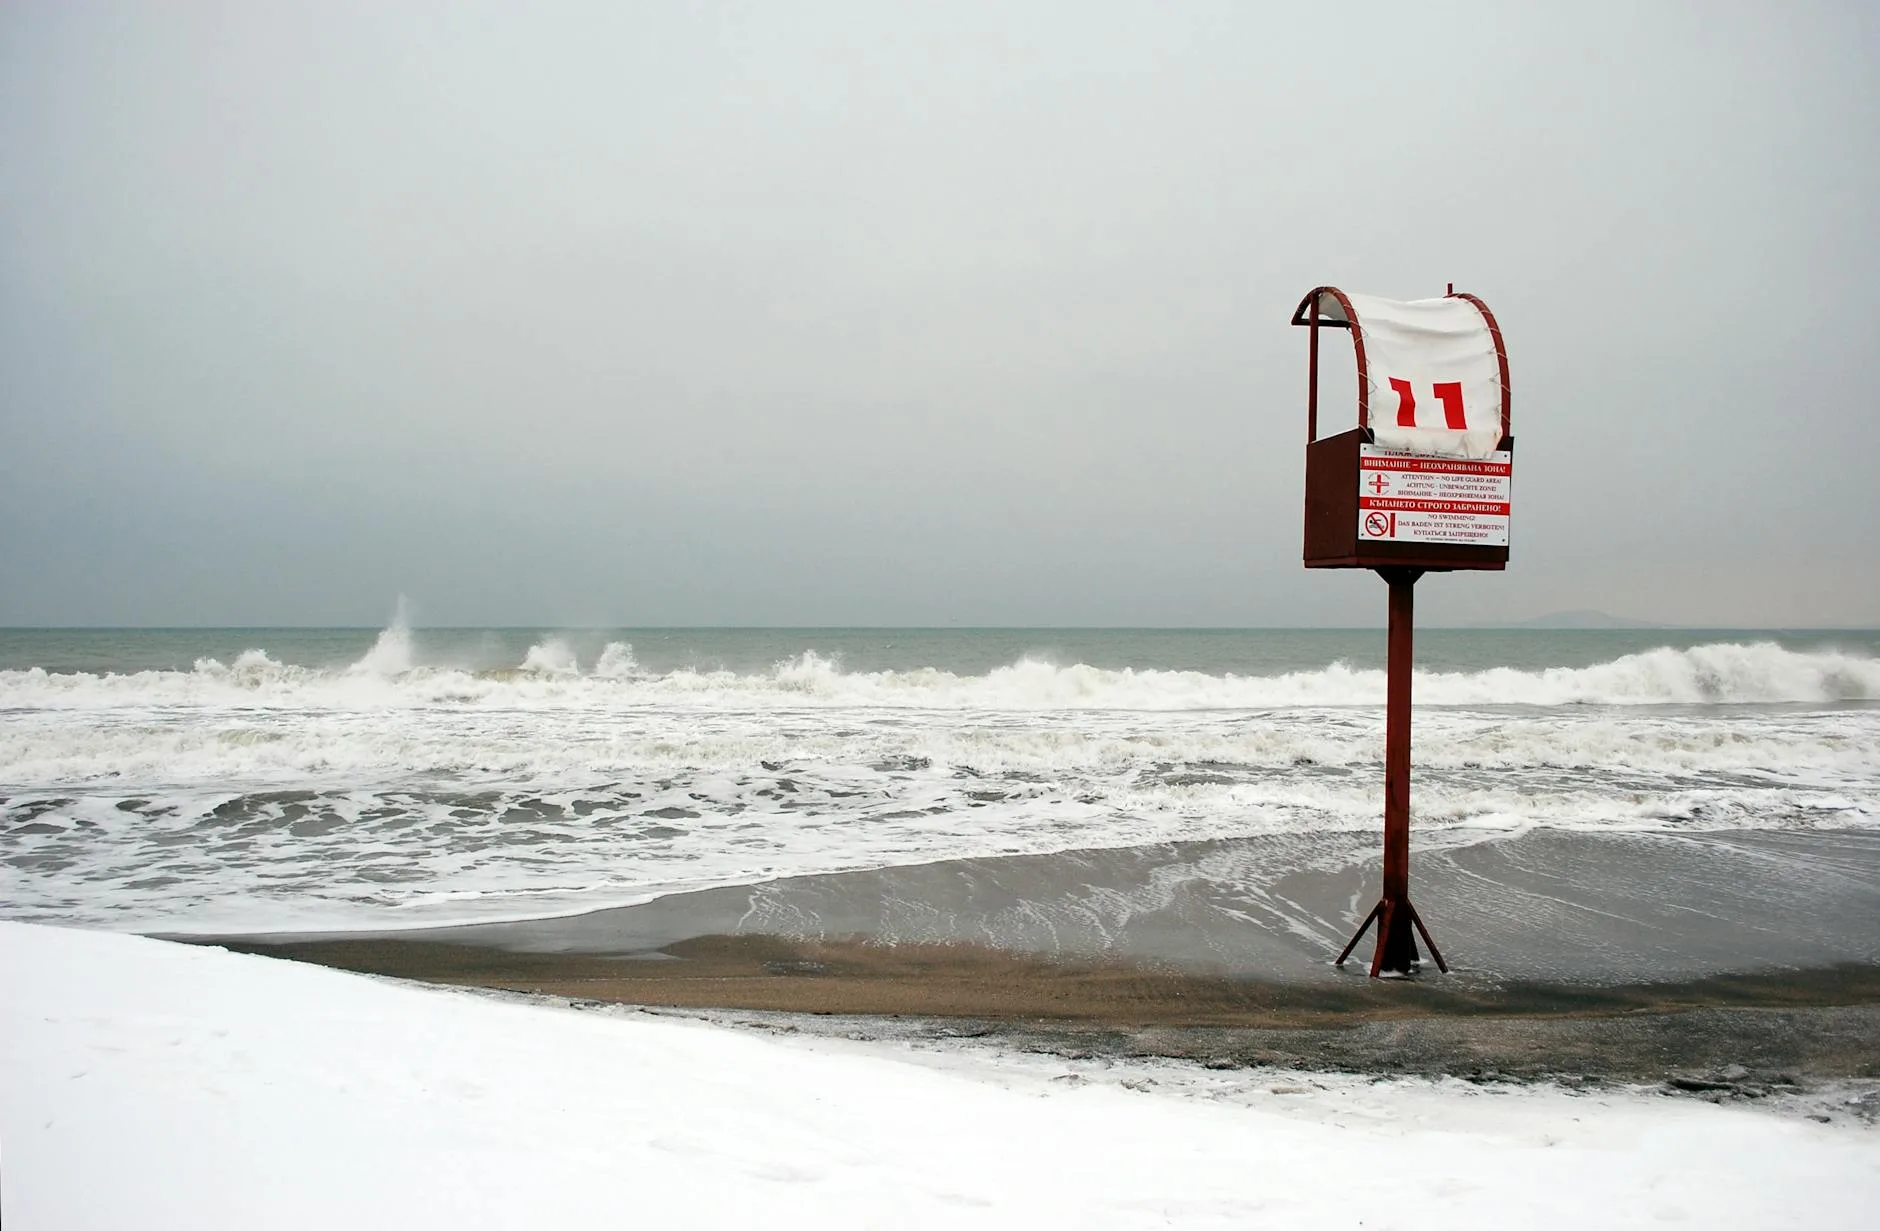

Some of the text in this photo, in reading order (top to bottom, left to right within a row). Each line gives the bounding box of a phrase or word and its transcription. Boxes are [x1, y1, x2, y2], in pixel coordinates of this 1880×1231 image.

[1388, 376, 1469, 431] 11
[1364, 459, 1411, 469] ВНИМАНИЕ
[1420, 462, 1482, 472] НЕОХРАНЯВАНА
[1484, 465, 1506, 474] ЗОНА!
[1488, 493, 1505, 501] ЗОНА!
[1369, 499, 1502, 513] КЪПАНЕТО СТРОГО ЗАБРАНЕНО!
[1413, 529, 1447, 537] КУПАТЬСЯ
